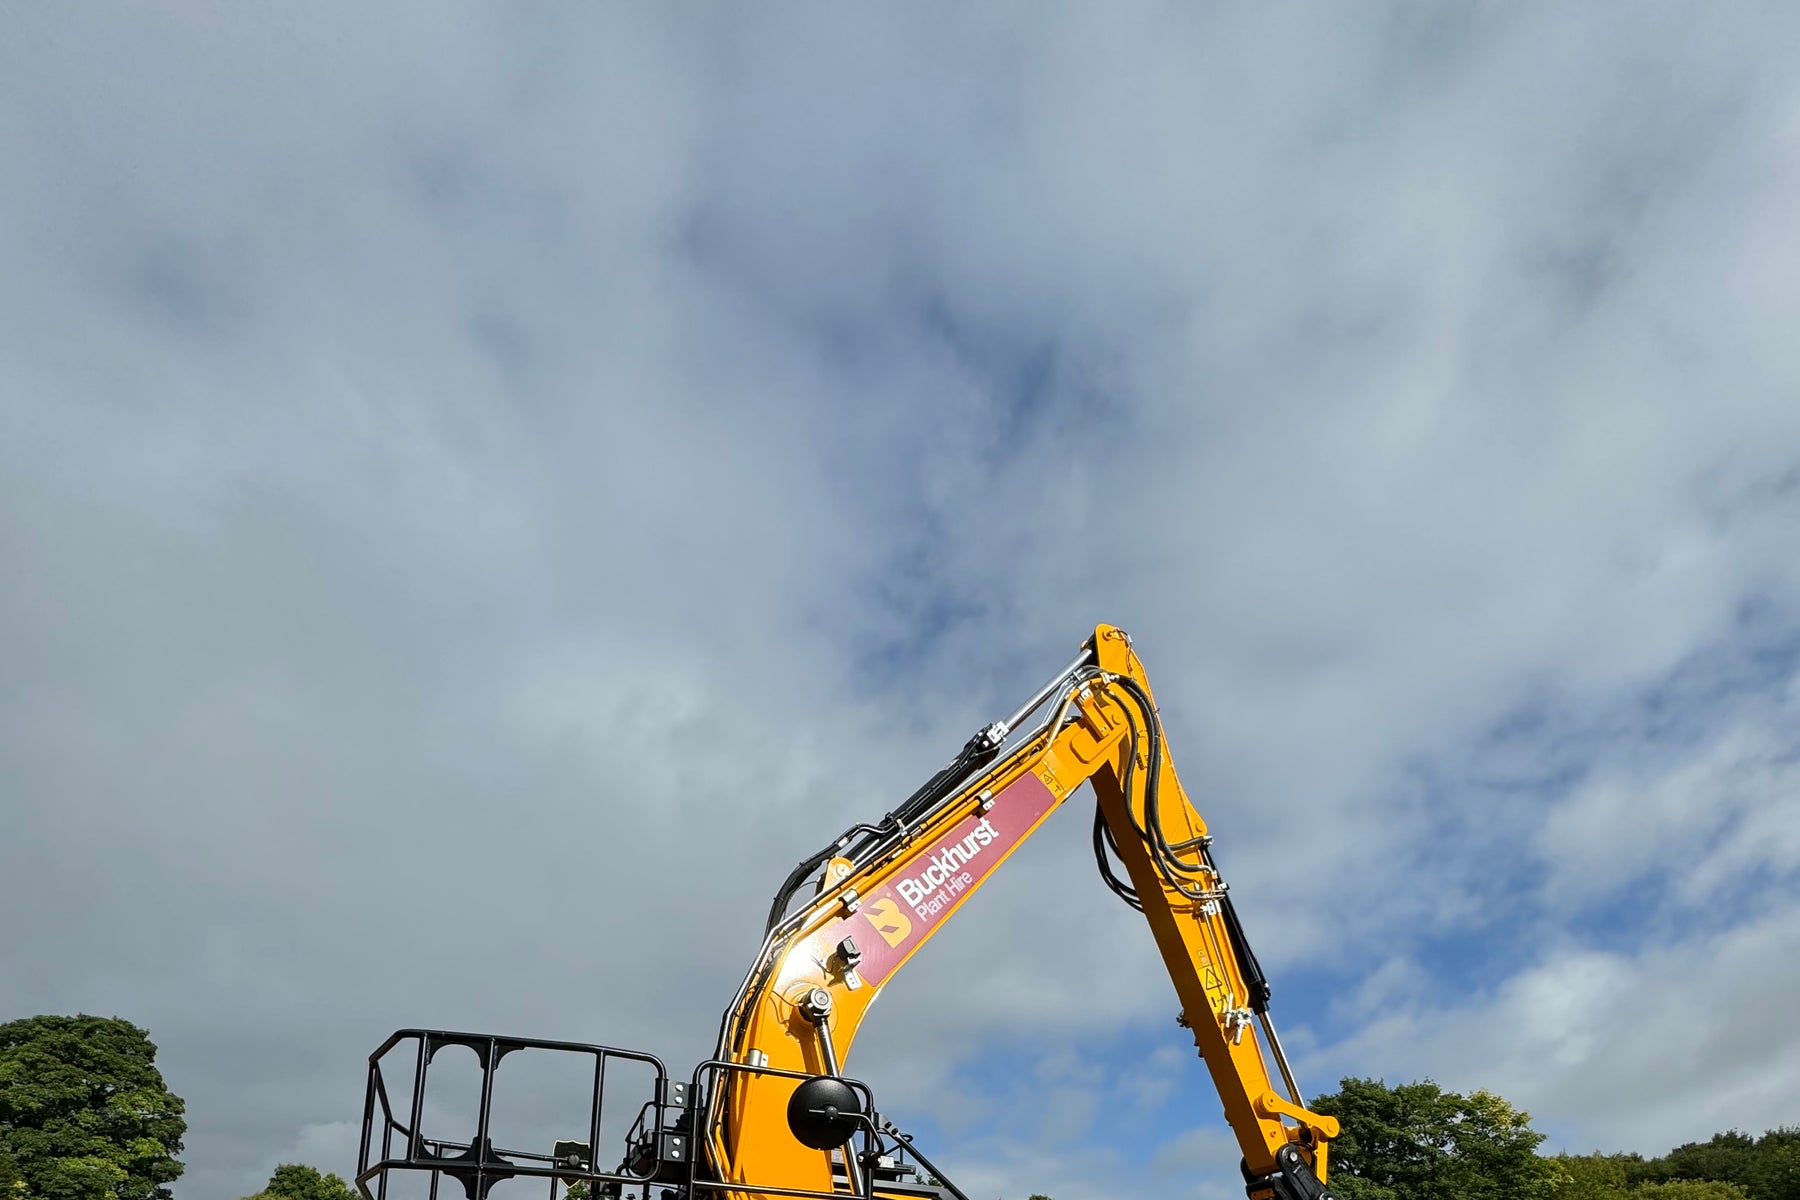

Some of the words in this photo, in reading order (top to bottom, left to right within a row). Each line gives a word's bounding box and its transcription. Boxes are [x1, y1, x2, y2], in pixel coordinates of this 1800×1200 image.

[895, 817, 1000, 909] Buckhurst
[914, 889, 952, 923] Plant
[944, 871, 974, 897] Hire
